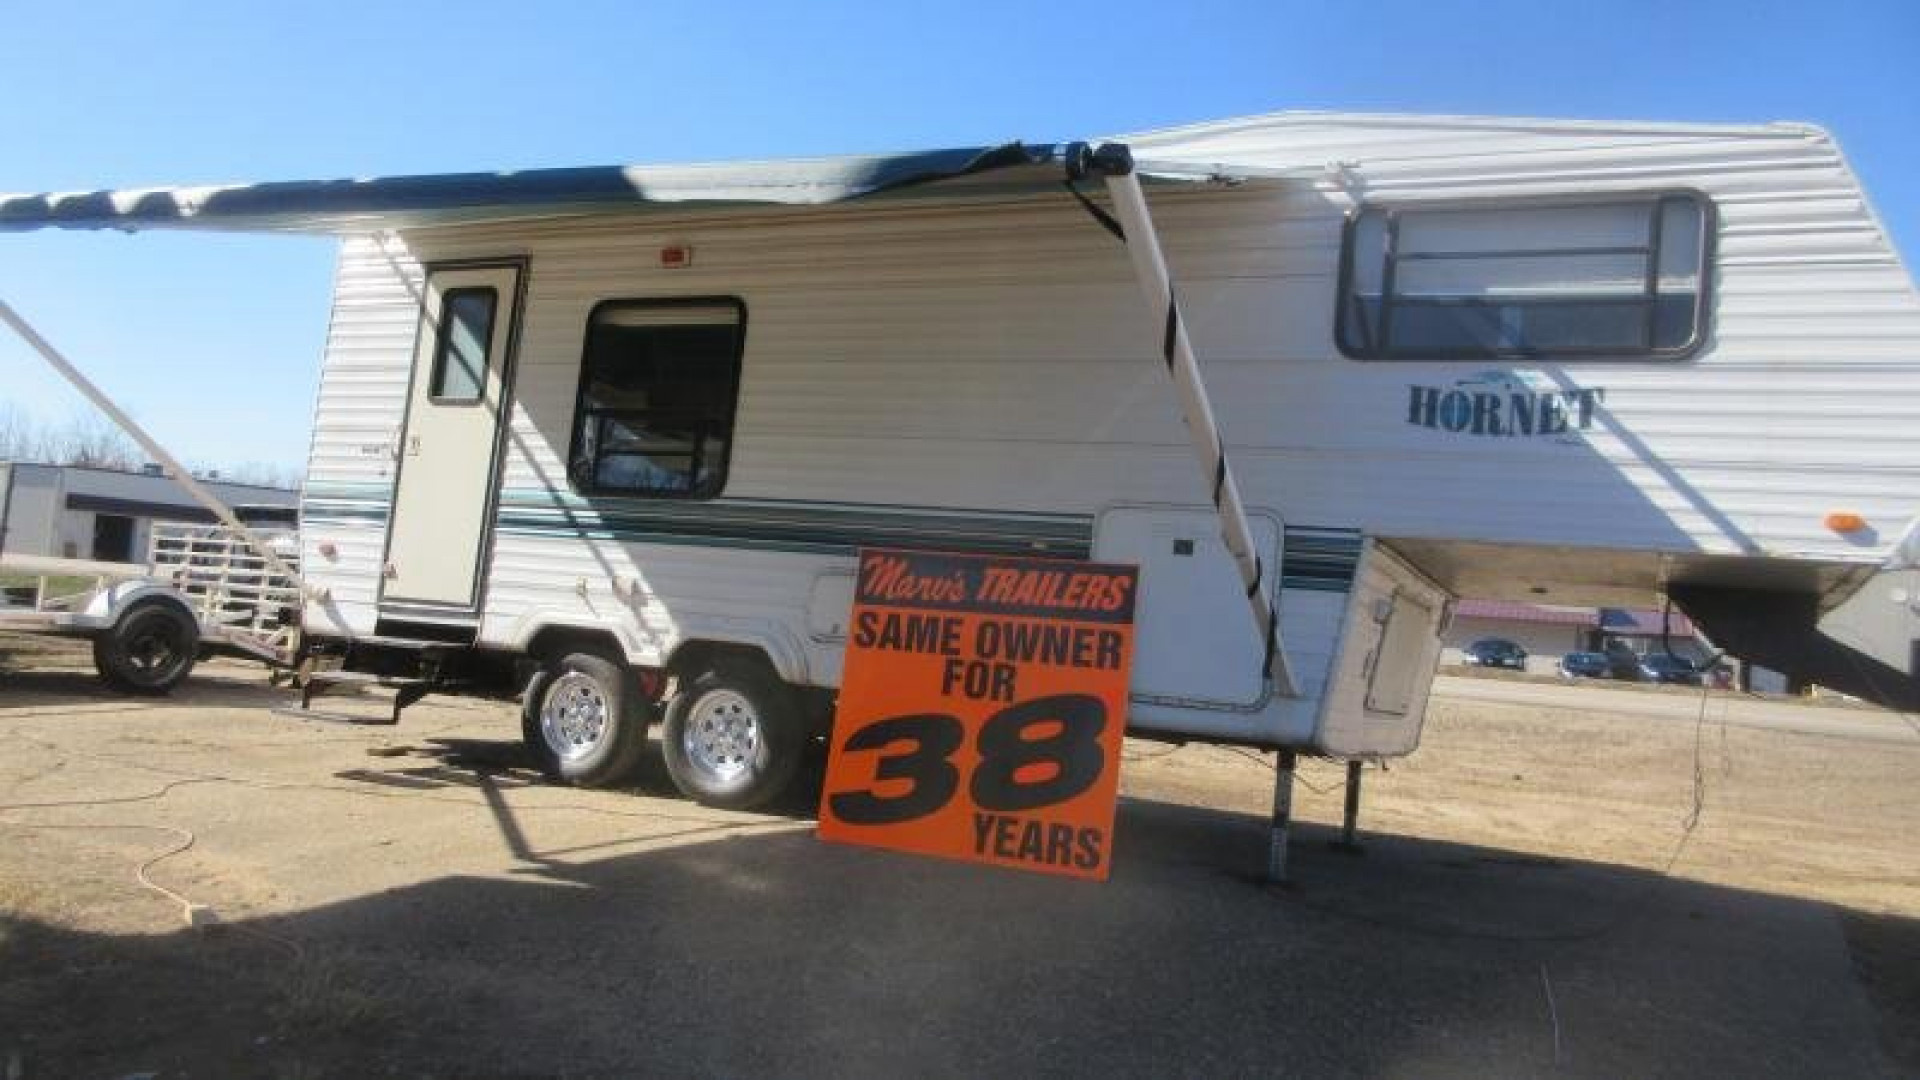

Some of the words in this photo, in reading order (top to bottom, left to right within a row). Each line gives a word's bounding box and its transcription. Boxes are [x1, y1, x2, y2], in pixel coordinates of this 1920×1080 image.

[1405, 384, 1604, 436] HORNET
[977, 568, 1132, 611] TRAILERS
[855, 612, 963, 655] SAME
[976, 621, 1122, 670] OWNER
[941, 659, 1017, 701] FOR
[829, 694, 1108, 825] 38
[972, 813, 1102, 869] YEARS
